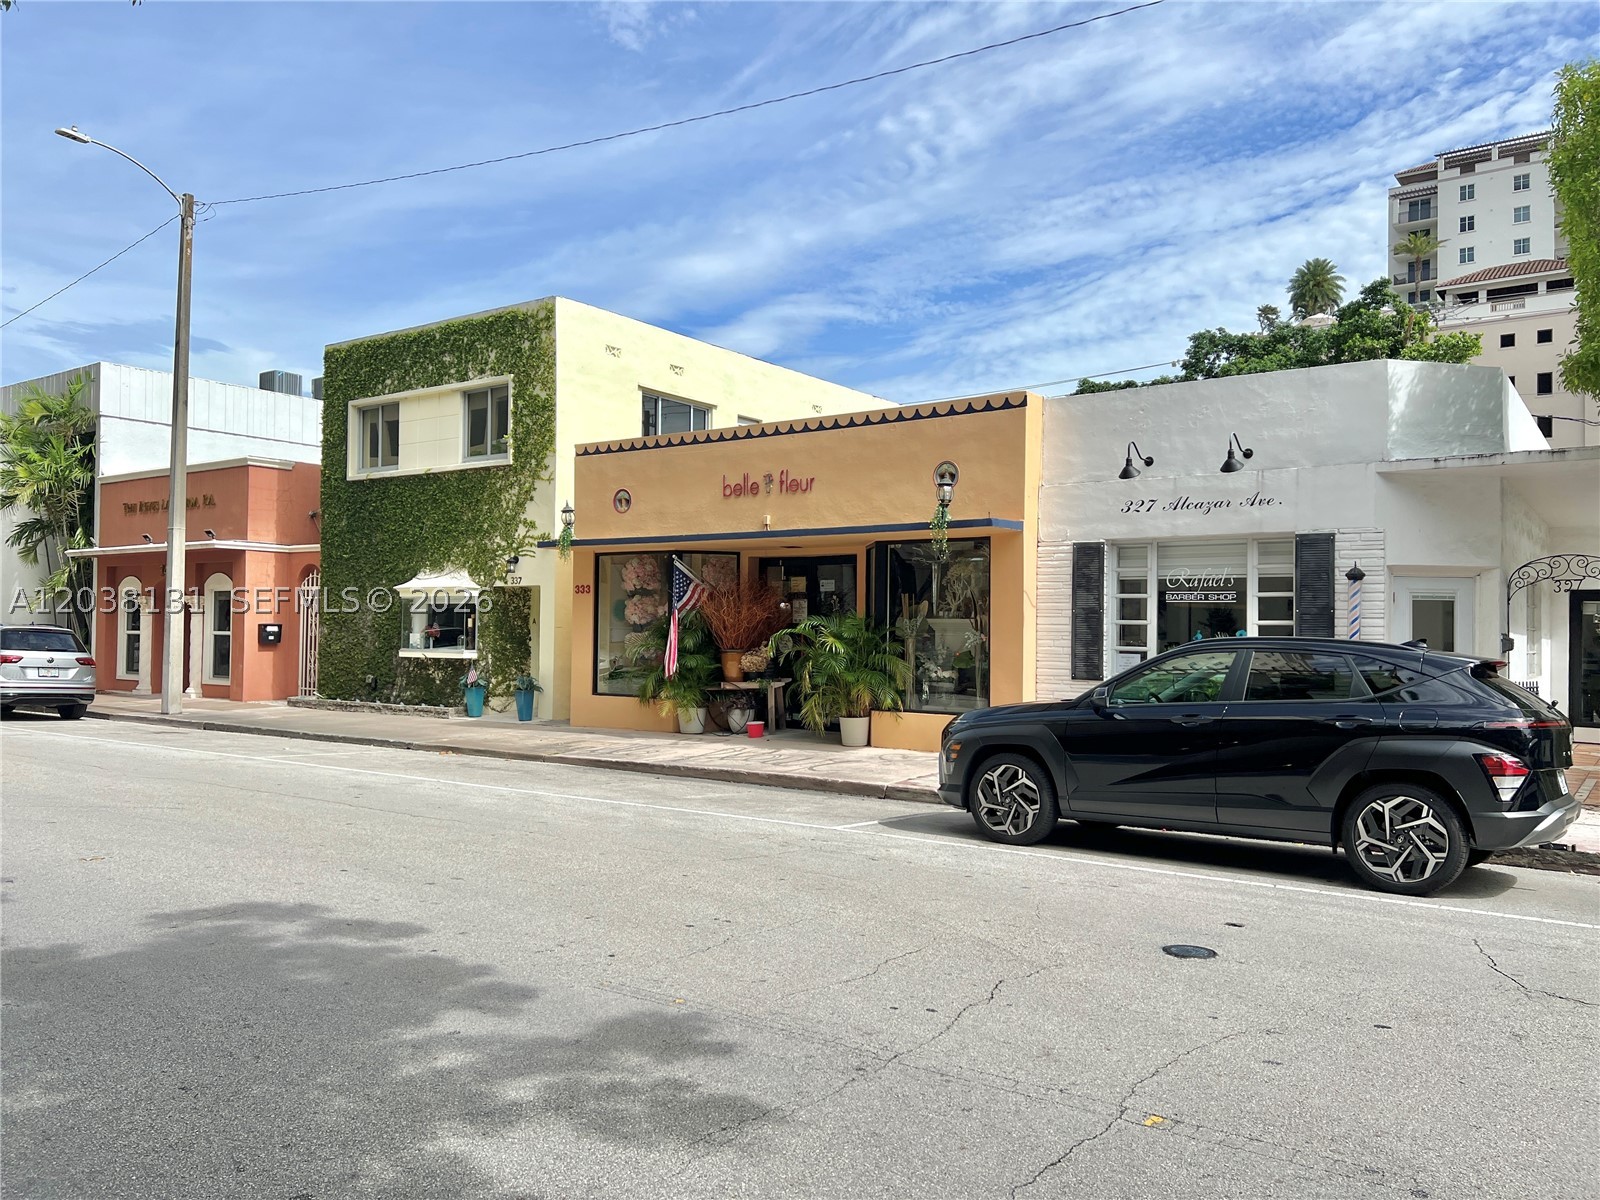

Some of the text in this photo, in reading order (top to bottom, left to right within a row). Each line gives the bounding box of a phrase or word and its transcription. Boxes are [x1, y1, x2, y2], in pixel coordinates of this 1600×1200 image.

[722, 469, 815, 497] belle fleur
[1120, 491, 1283, 516] 327 Alcazar Ave.
[510, 576, 523, 585] 337
[1166, 567, 1237, 594] Rafael's
[1553, 579, 1583, 594] 327
[574, 584, 591, 594] 333
[1165, 593, 1237, 601] BARBER SHOP
